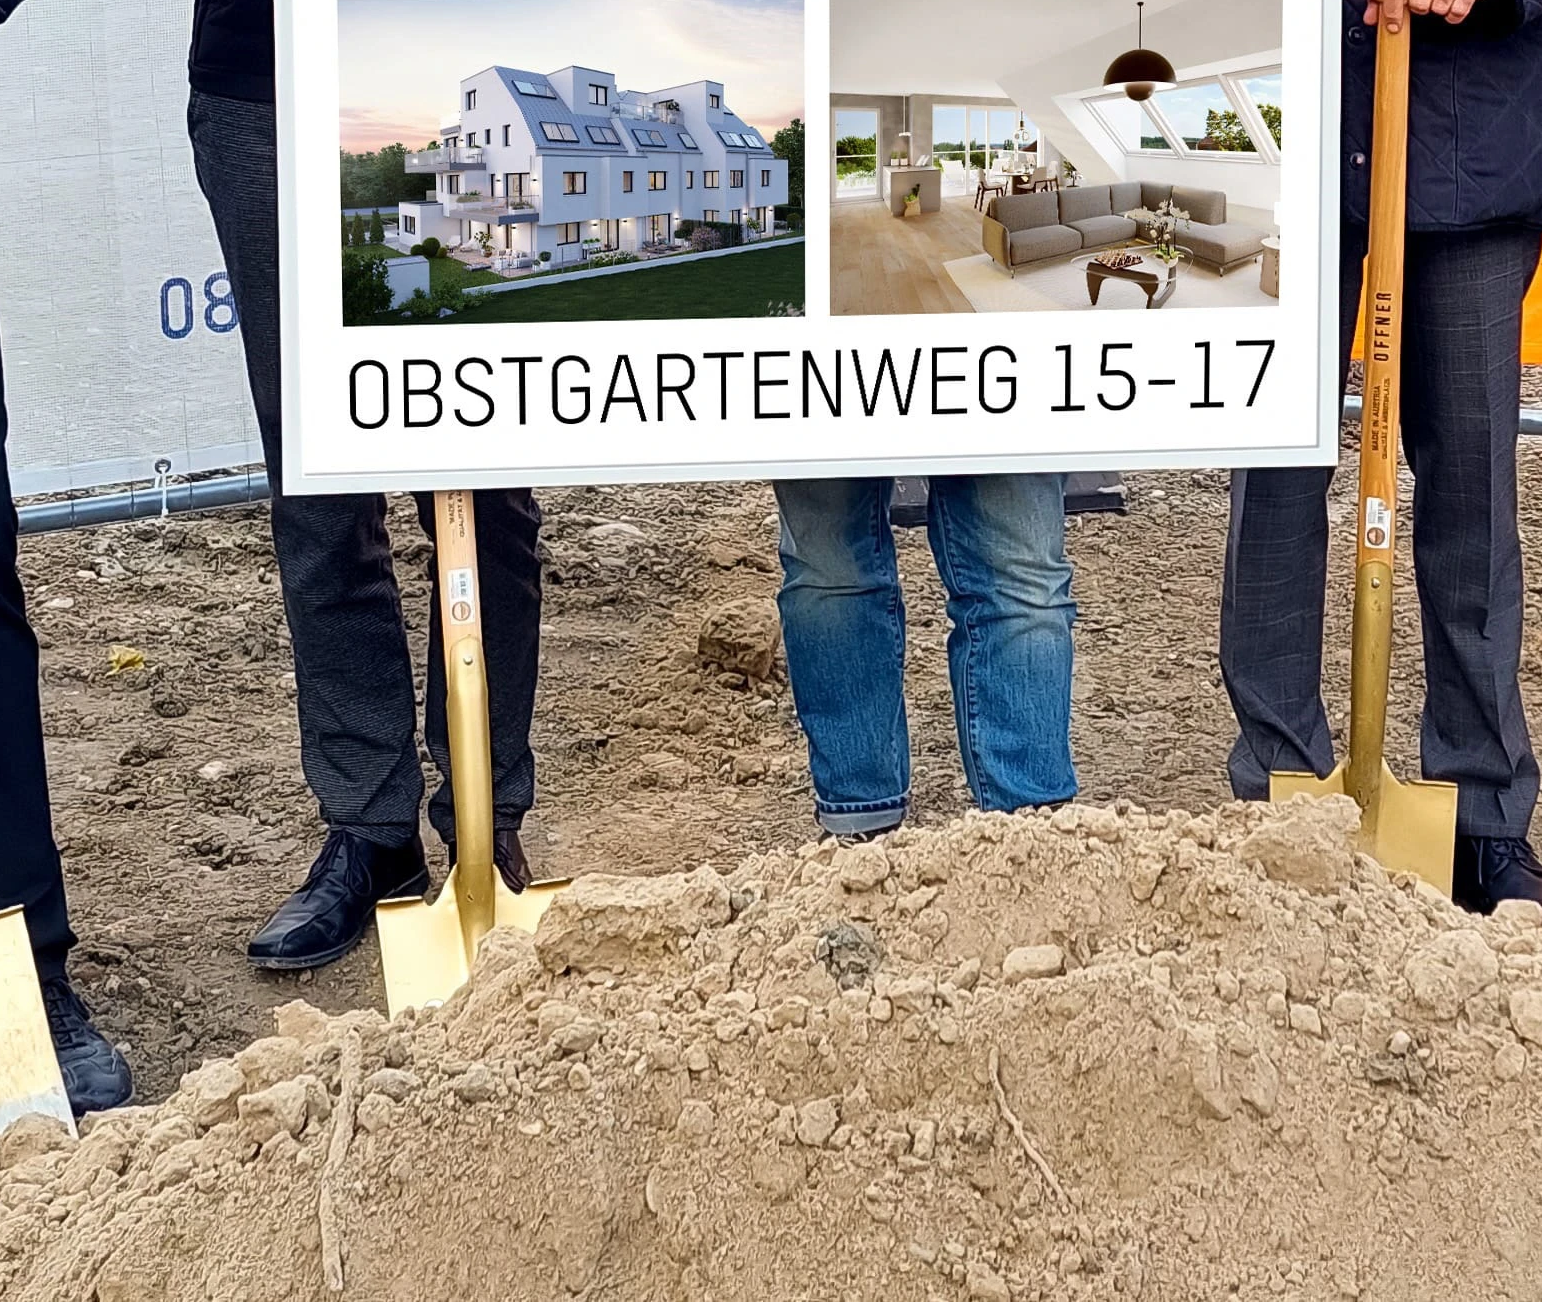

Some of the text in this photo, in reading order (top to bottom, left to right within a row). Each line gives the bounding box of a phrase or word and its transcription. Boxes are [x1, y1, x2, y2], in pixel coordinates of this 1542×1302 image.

[1373, 291, 1392, 362] OFFNER
[349, 339, 1276, 430] OBSTGARTENWEG 15-17
[1372, 385, 1381, 451] MADE IN AUSTRIA
